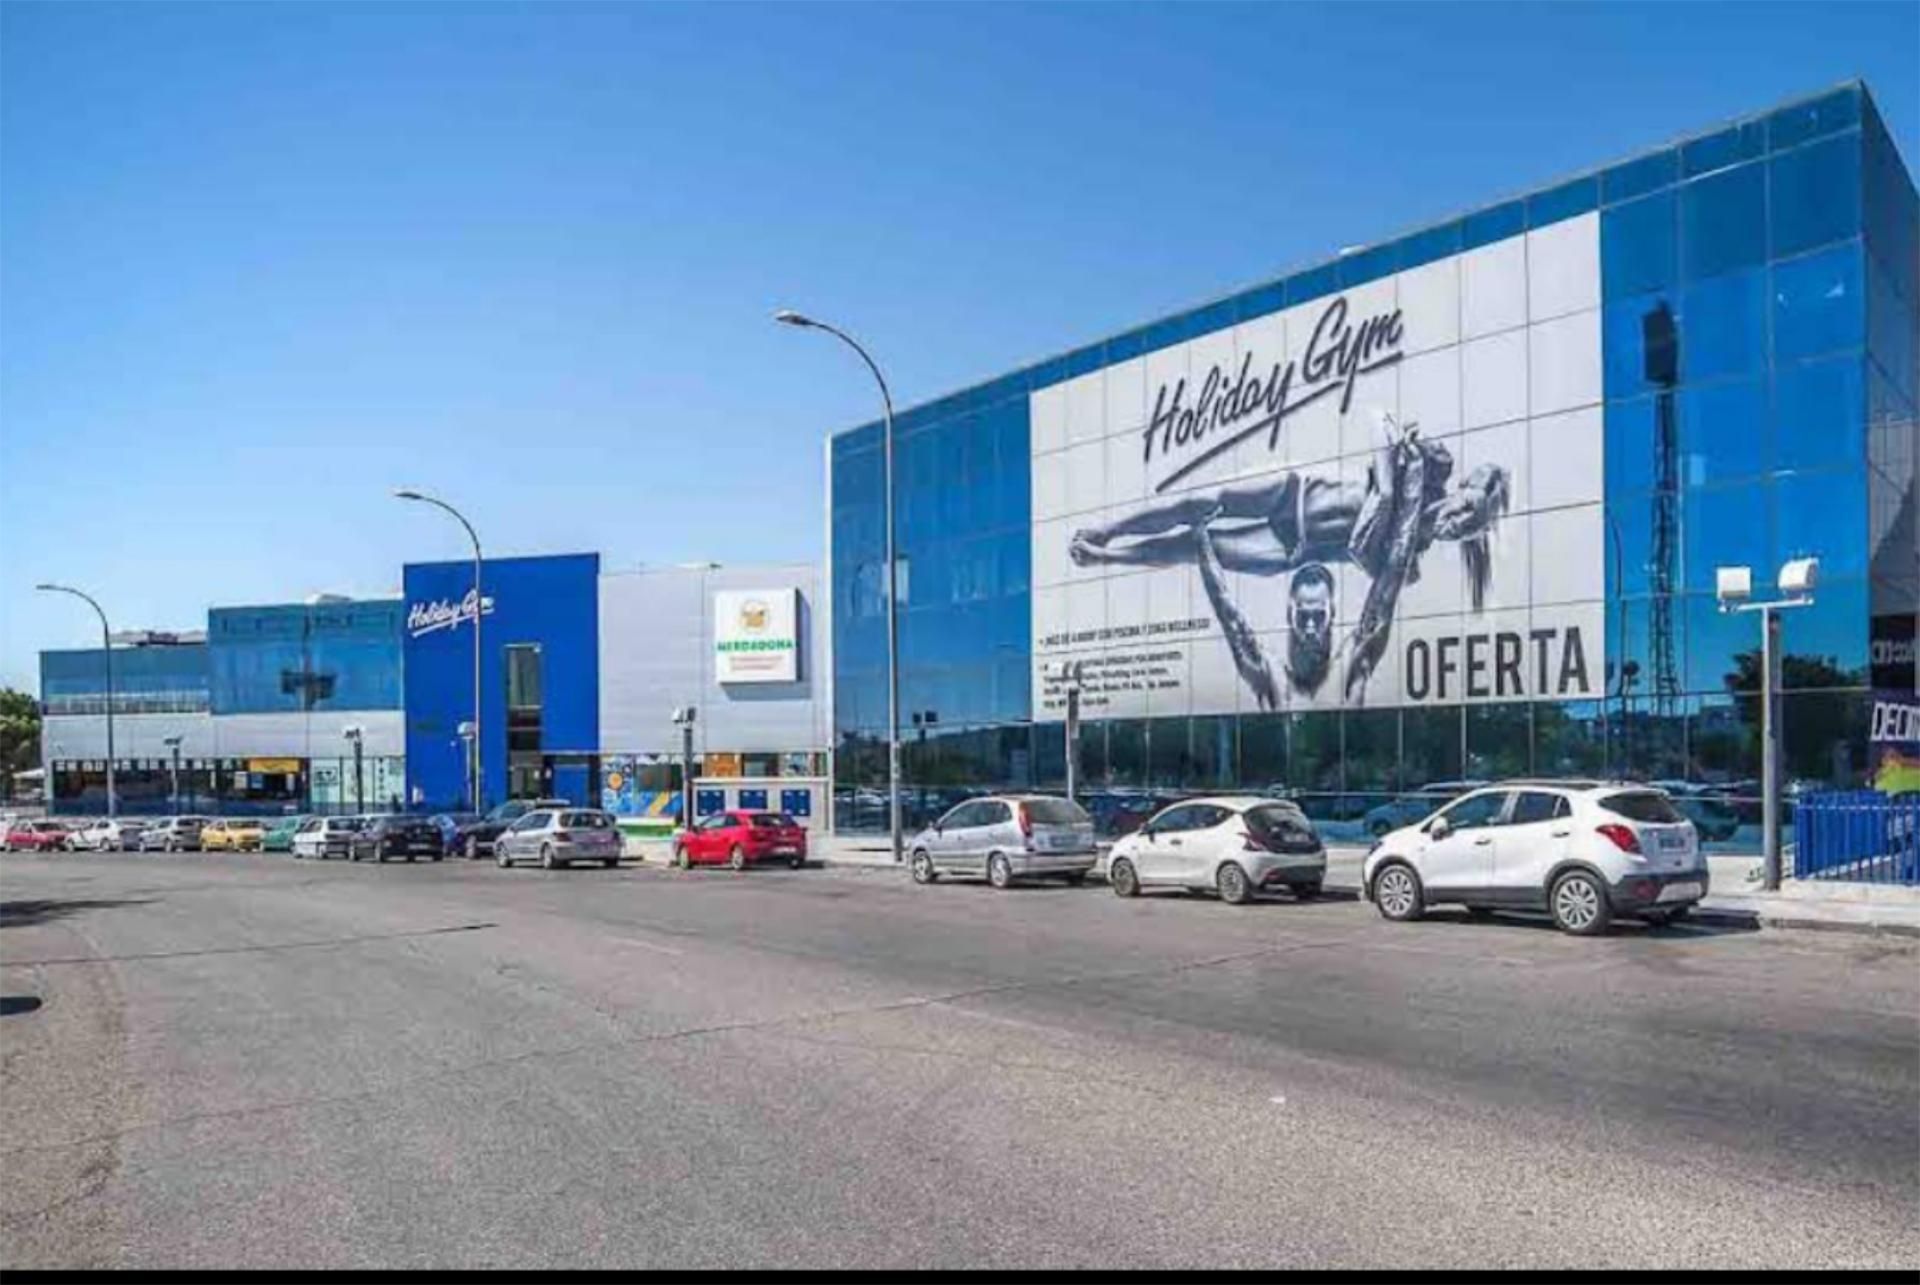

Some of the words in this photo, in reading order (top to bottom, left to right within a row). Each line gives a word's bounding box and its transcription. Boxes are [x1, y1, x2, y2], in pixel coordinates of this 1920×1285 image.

[1143, 351, 1295, 463] Holiday
[1302, 296, 1404, 415] Gym
[717, 639, 794, 652] MERCADONA
[1406, 626, 1590, 700] OFERTA
